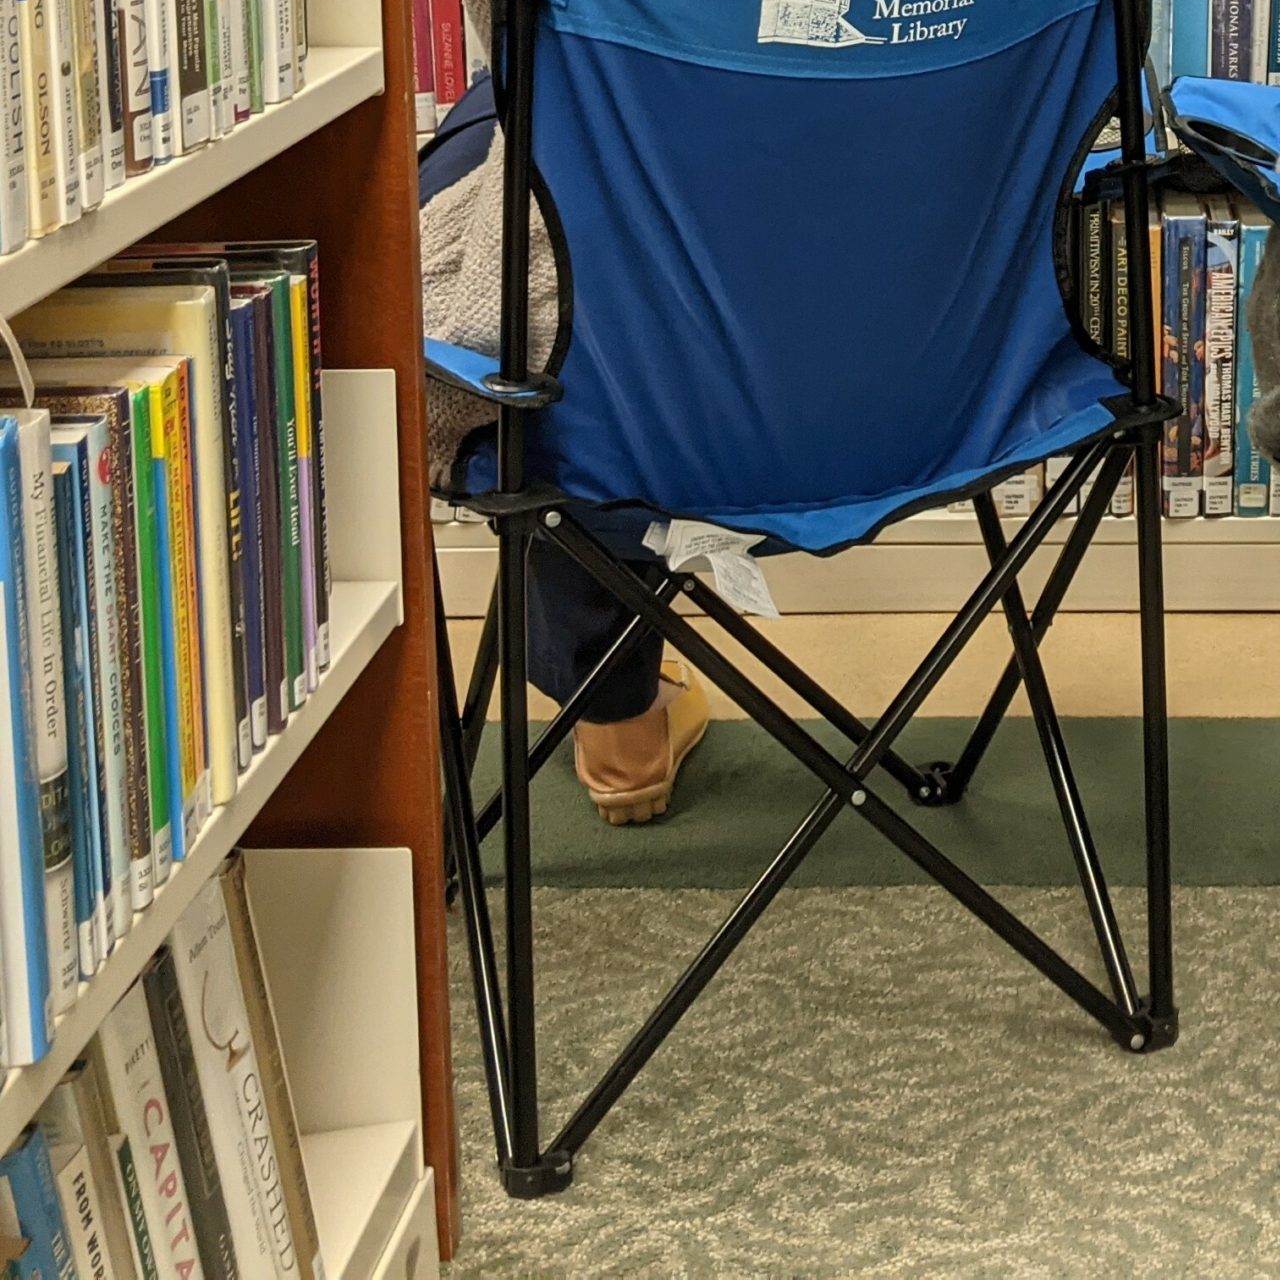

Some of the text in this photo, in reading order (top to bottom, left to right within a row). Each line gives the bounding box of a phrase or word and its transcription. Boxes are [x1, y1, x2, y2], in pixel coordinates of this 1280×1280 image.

[890, 18, 968, 44] Library
[1228, 43, 1238, 79] PARKS
[1211, 273, 1233, 359] AMERICAN EPICS
[1220, 362, 1232, 464] THOMAS HART BENTON
[30, 471, 58, 740] My Financial Life in Order
[241, 1072, 296, 1273] CRASHED
